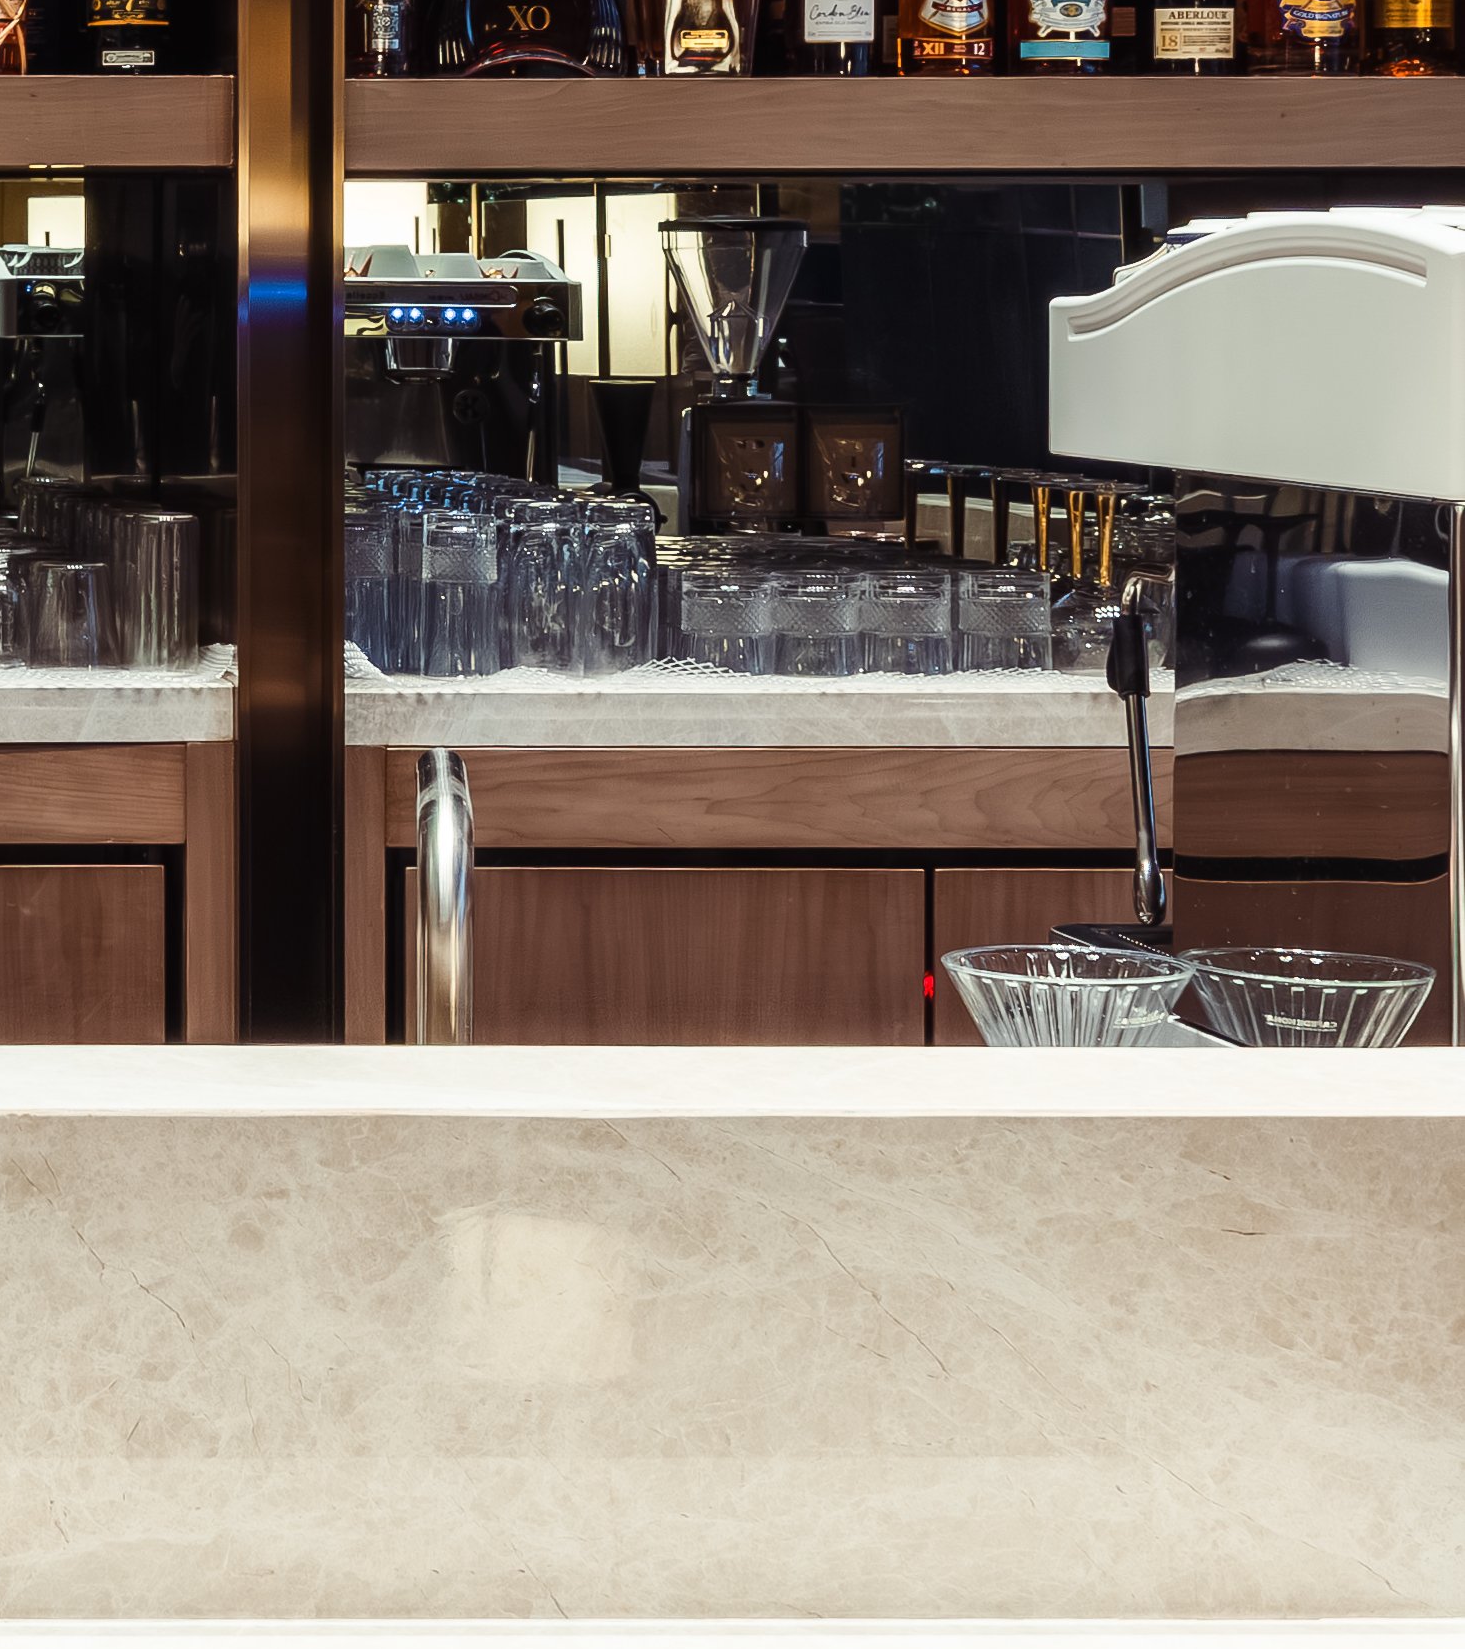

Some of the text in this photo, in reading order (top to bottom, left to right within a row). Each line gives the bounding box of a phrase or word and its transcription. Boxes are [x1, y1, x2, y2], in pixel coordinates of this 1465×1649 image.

[507, 5, 551, 31] XO
[1168, 10, 1229, 20] ABERLOUR
[1161, 33, 1178, 48] 18
[922, 42, 945, 56] XII
[973, 43, 985, 57] 12
